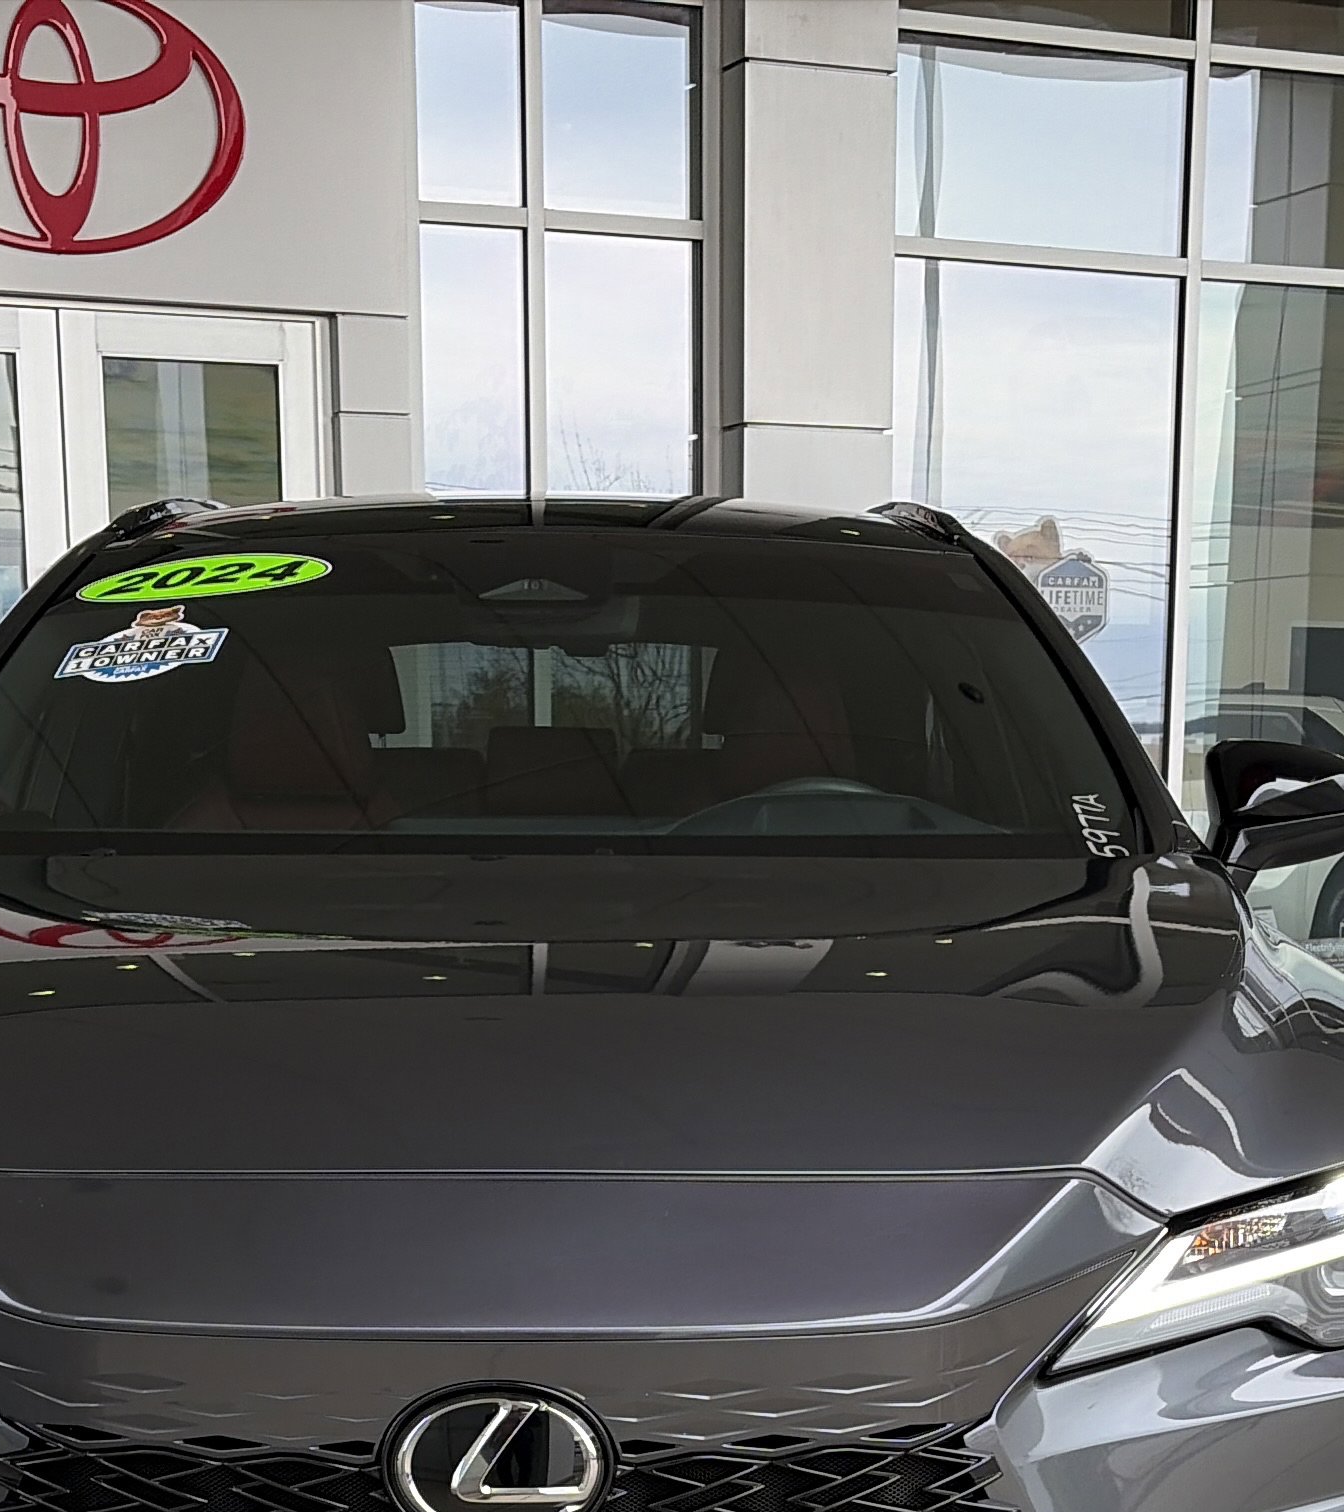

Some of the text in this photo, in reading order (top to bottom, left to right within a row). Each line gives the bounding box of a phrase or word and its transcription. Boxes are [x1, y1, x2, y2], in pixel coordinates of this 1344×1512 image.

[97, 561, 309, 598] 2024
[1048, 576, 1098, 587] CARFAX
[78, 636, 213, 657] CARFAX
[93, 648, 206, 668] OWNER
[1072, 794, 1130, 857] 5977A
